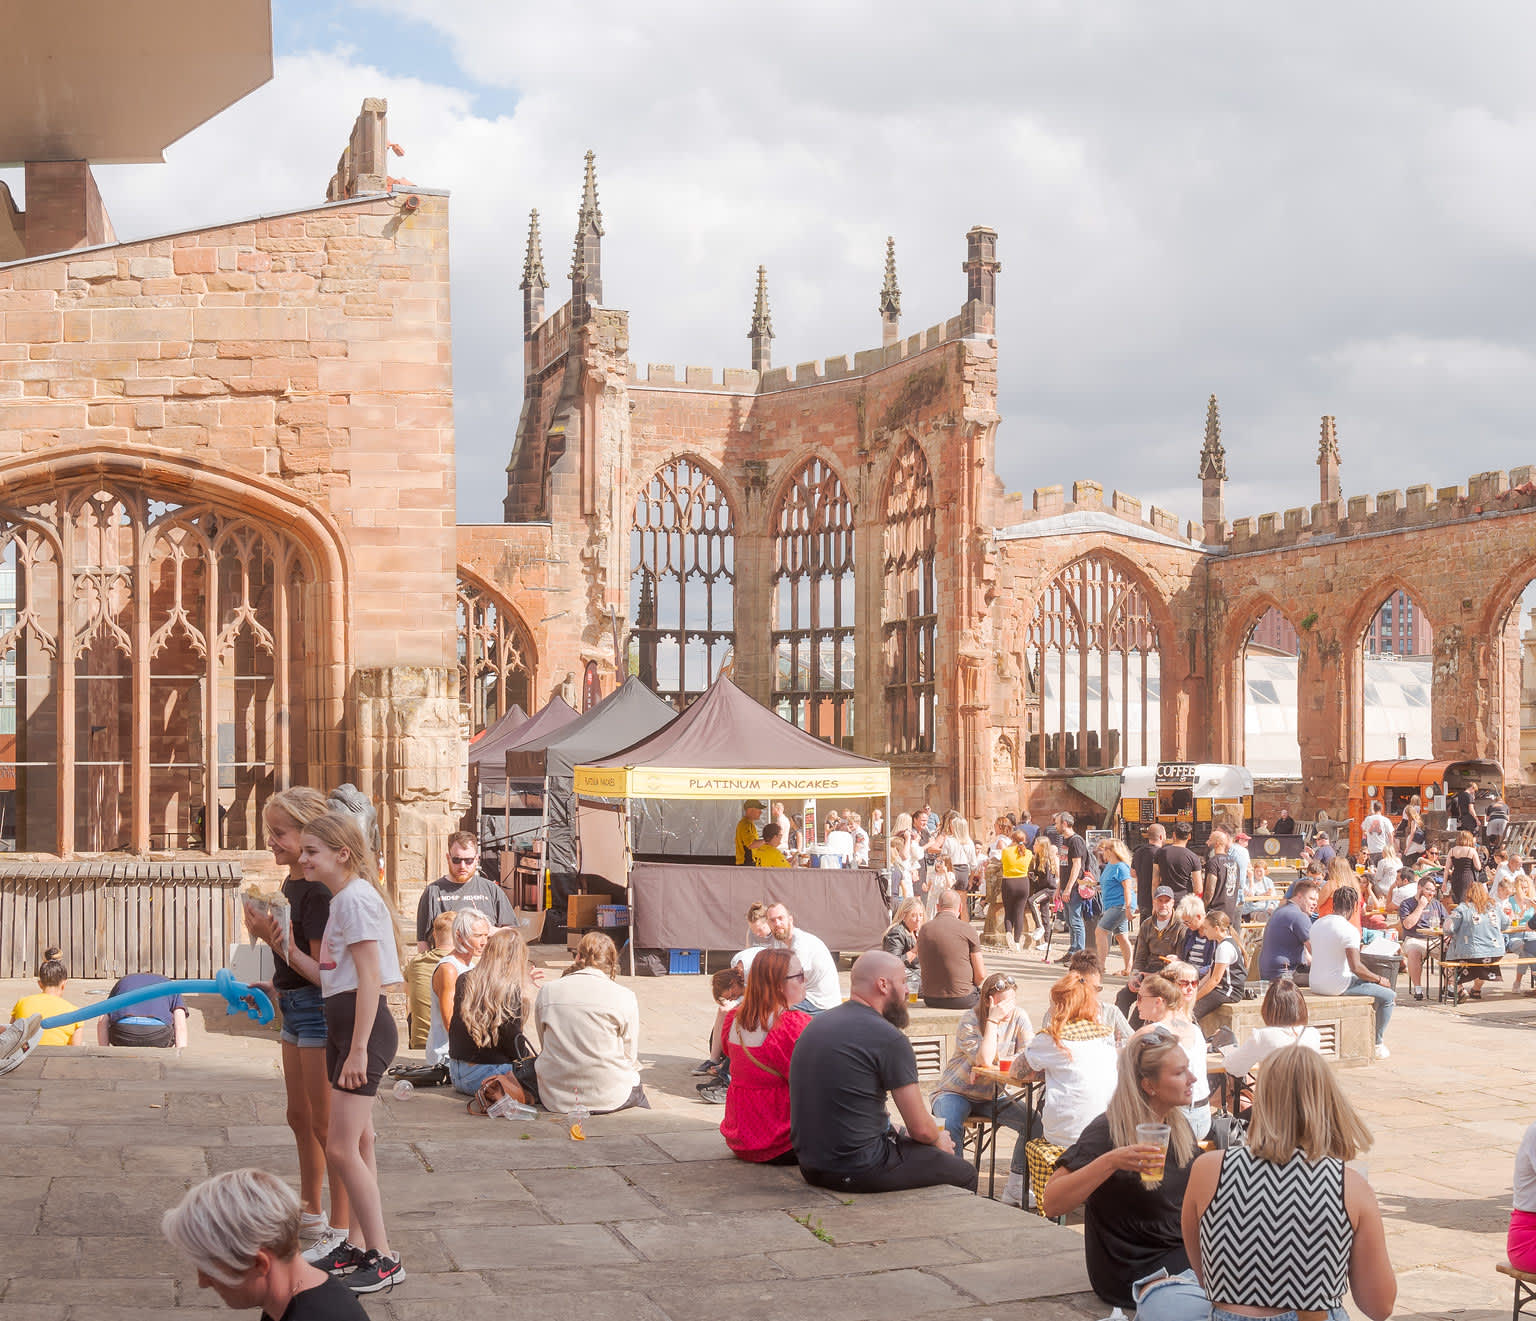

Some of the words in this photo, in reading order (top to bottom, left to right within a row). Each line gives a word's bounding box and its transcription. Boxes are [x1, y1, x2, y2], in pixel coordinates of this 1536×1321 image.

[1156, 766, 1195, 777] COFFEE
[689, 779, 761, 790] PLATINUM
[771, 779, 839, 790] PANCAKES
